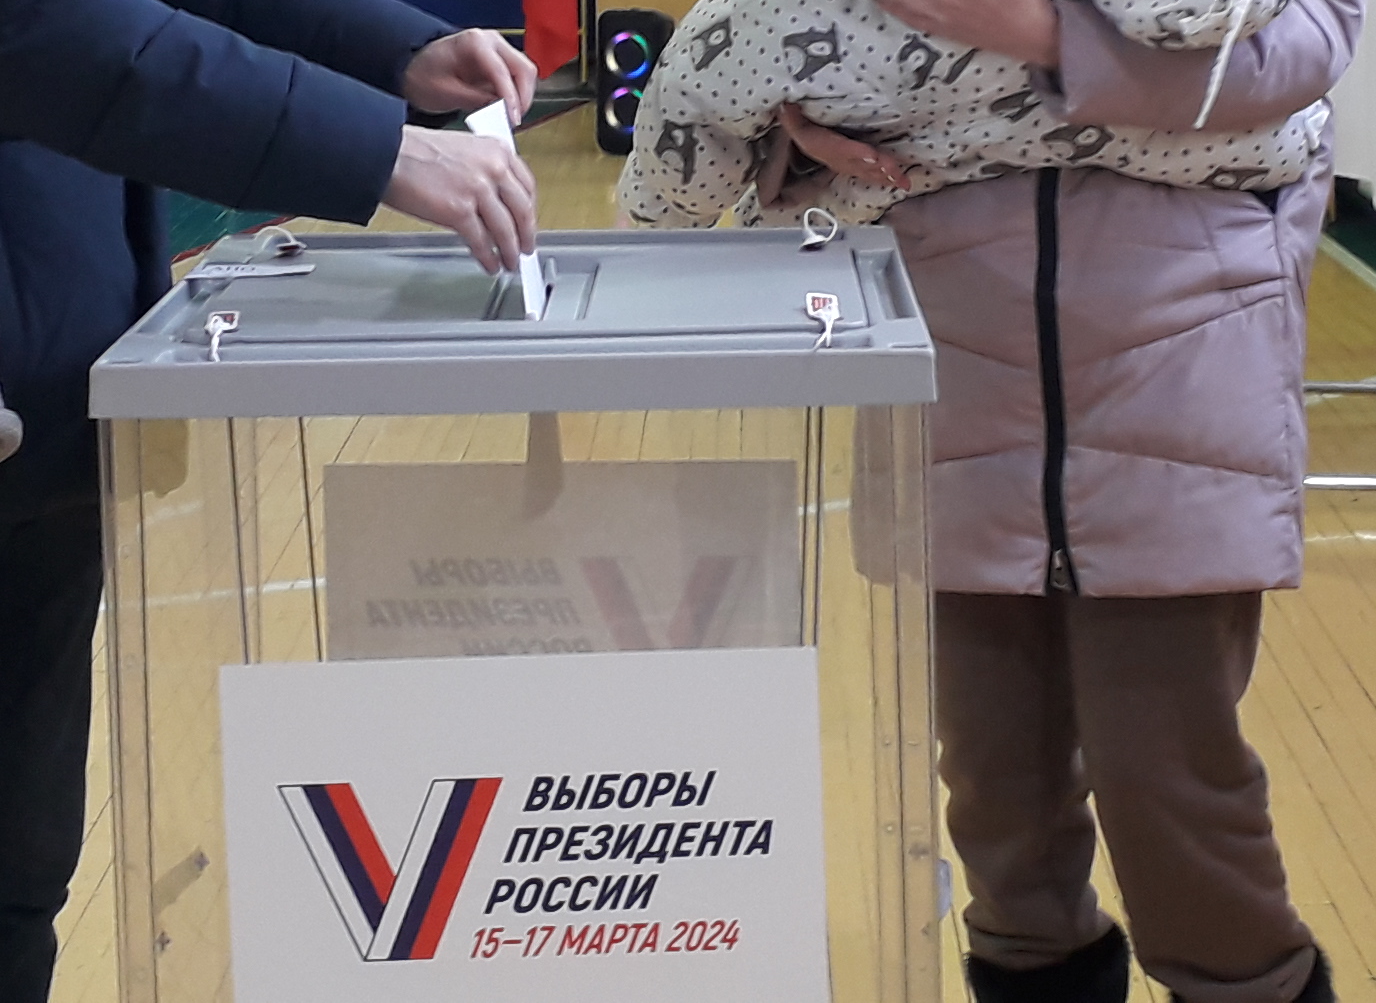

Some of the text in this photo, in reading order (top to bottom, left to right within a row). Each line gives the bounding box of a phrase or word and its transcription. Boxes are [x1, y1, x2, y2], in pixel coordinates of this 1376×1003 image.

[523, 771, 716, 812] ВЫБОРЫ
[504, 820, 773, 864] ПРЕЗИДЕНТА
[484, 874, 659, 914] РОССИИ
[557, 922, 658, 956] МАРТА
[665, 919, 740, 952] 2024
